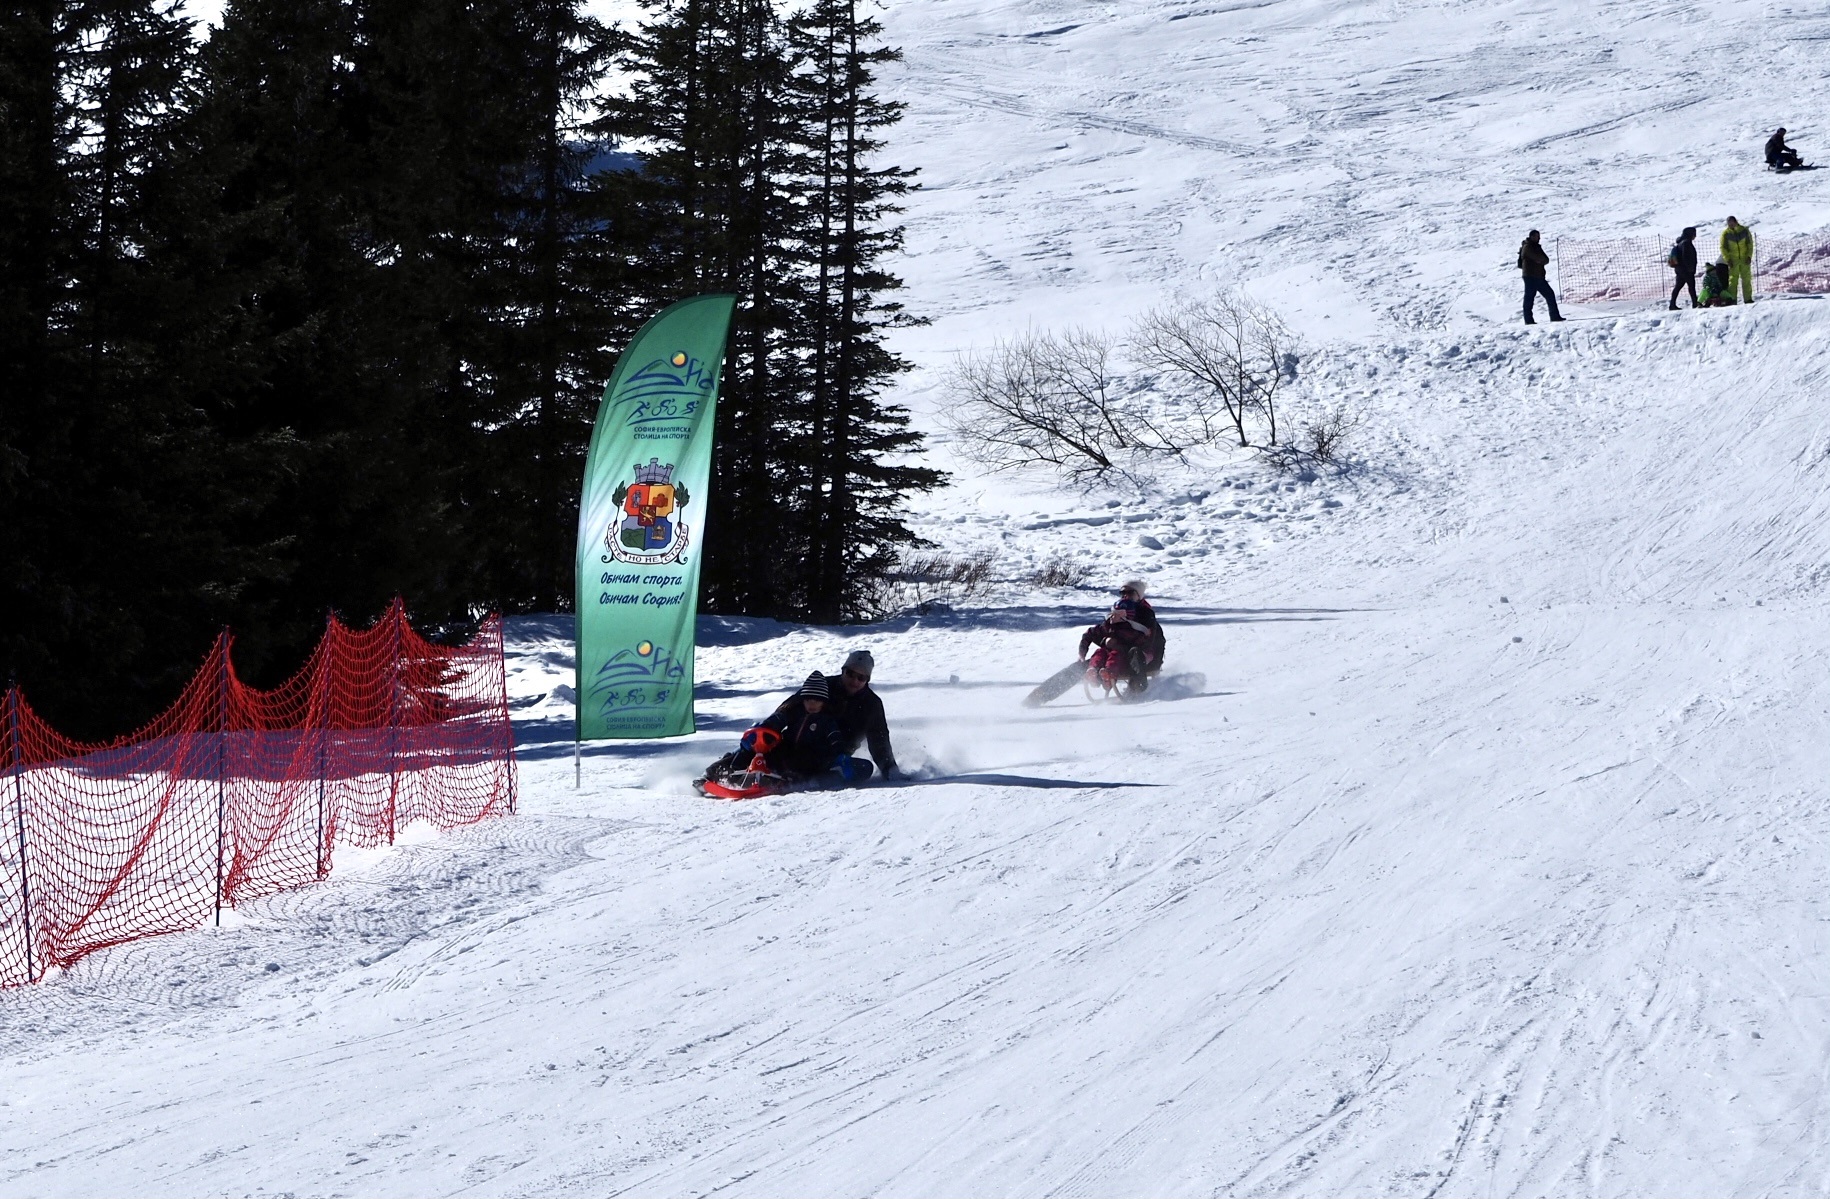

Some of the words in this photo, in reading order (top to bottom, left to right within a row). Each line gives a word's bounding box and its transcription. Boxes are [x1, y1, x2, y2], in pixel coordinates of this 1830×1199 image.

[628, 555, 642, 563] НО
[601, 571, 640, 585] Обичам
[599, 591, 640, 605] Обичам
[642, 591, 685, 609] София!
